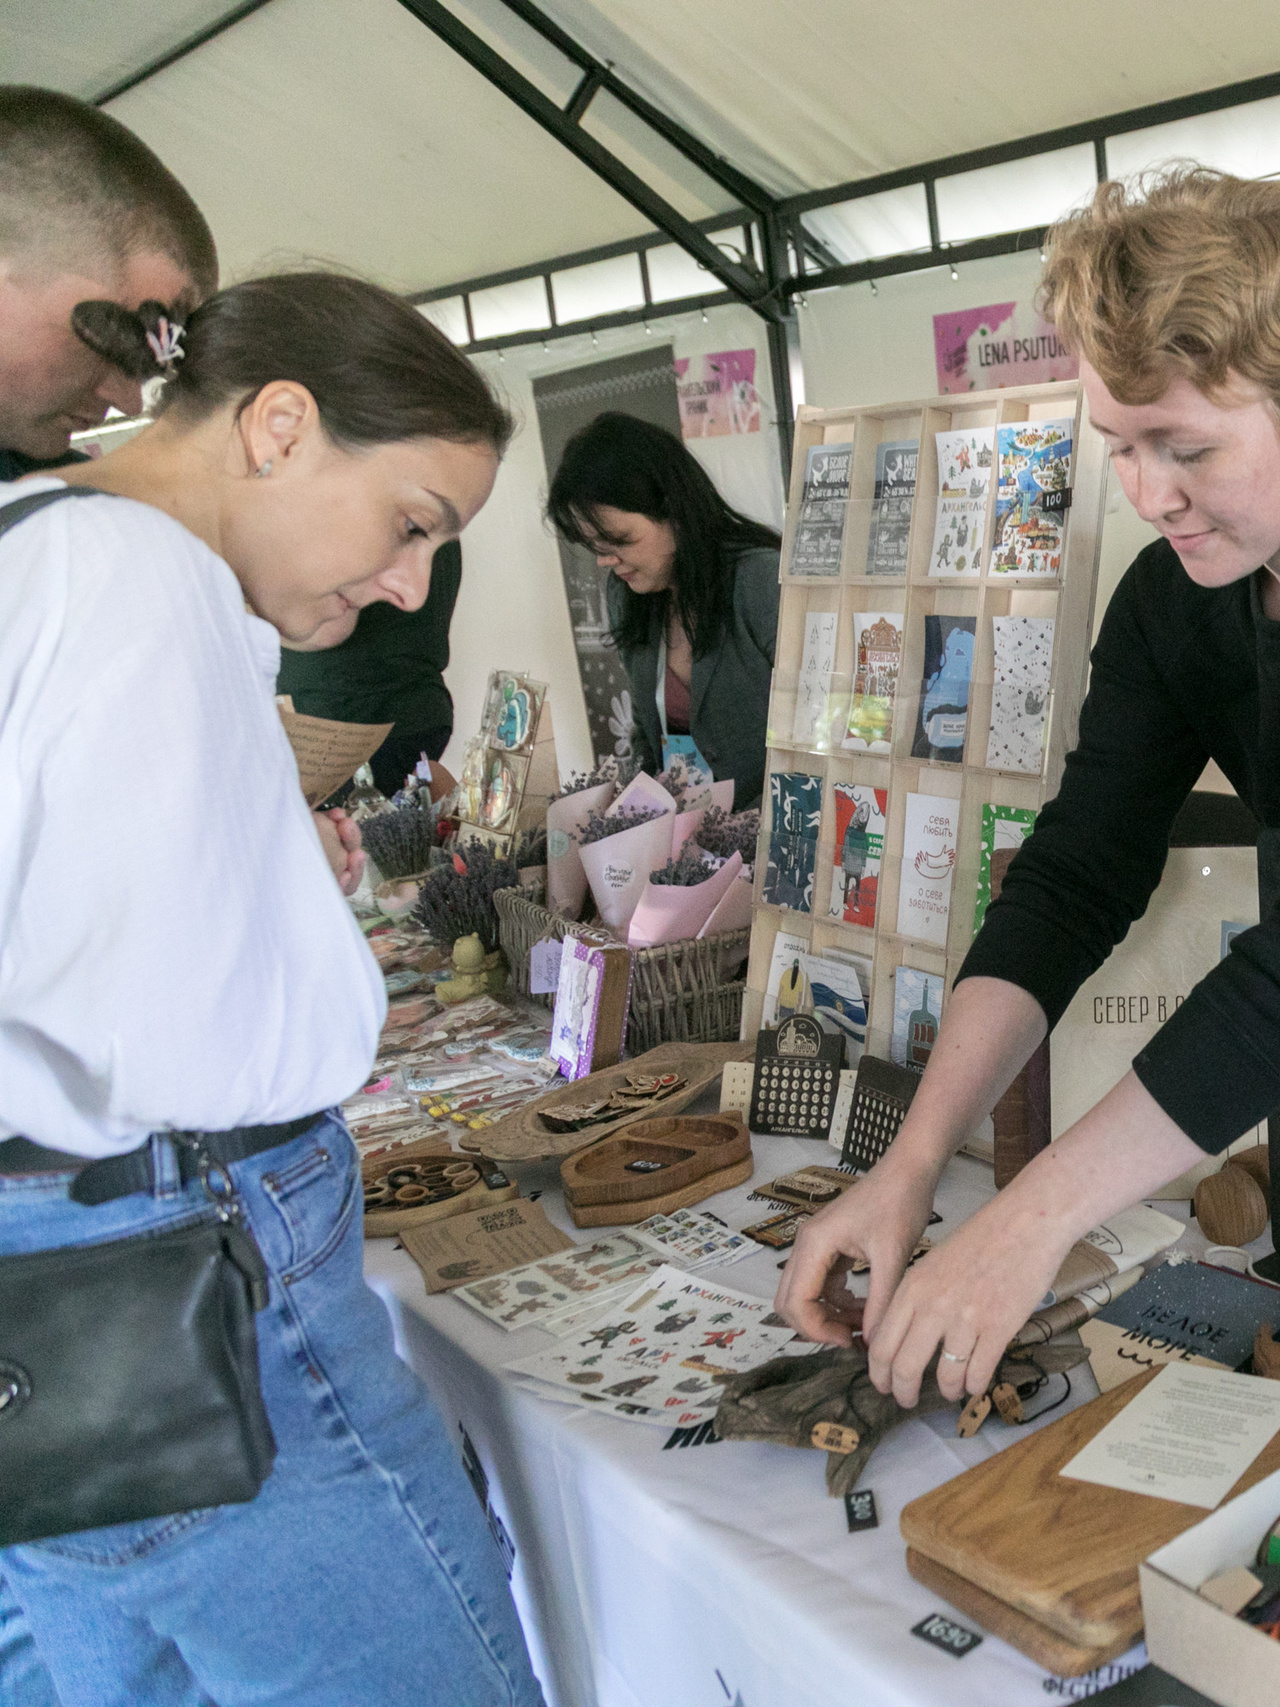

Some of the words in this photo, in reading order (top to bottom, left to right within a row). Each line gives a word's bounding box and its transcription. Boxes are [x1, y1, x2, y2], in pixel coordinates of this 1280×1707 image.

[978, 341, 1010, 367] LENA
[1046, 493, 1062, 506] 100
[923, 825, 953, 837] ЛЮБИТЬ
[918, 888, 923, 896] О
[909, 898, 948, 914] ЗАБОТИТЬСЯ
[1093, 996, 1149, 1024] СЕВЕР
[1158, 996, 1167, 1023] В
[679, 1284, 767, 1312] АРХАНГЕЛЬСК
[1142, 1305, 1229, 1343] БЕЛОЕ
[1121, 1326, 1200, 1361] МОРЕ
[921, 1616, 972, 1648] 1690
